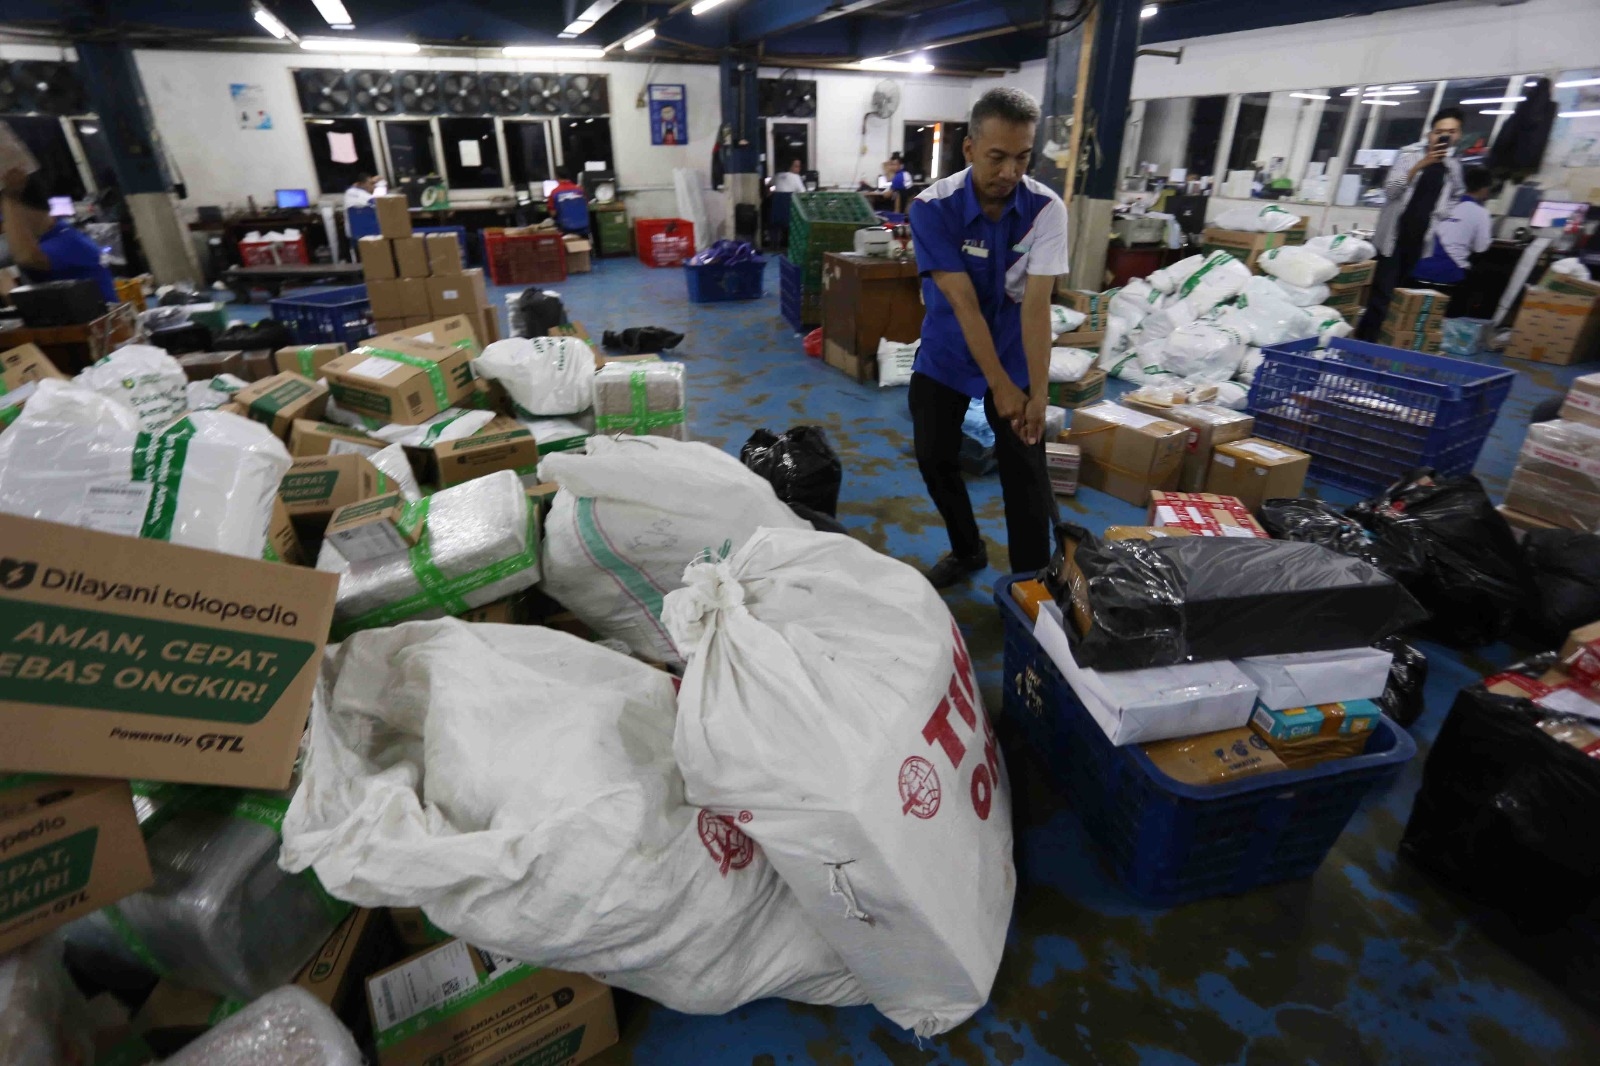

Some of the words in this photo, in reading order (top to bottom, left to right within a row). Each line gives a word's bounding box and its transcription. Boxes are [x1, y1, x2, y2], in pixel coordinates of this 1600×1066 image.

[41, 568, 160, 605] Dilayani
[163, 589, 298, 627] tokopedia
[13, 620, 147, 661] AMAN,
[161, 640, 279, 678] CEPAT,
[113, 667, 269, 704] ONGKIR!
[110, 727, 173, 746] Powered
[174, 733, 193, 746] by
[196, 733, 245, 753] GTL
[495, 1002, 550, 1037] Tokopedia
